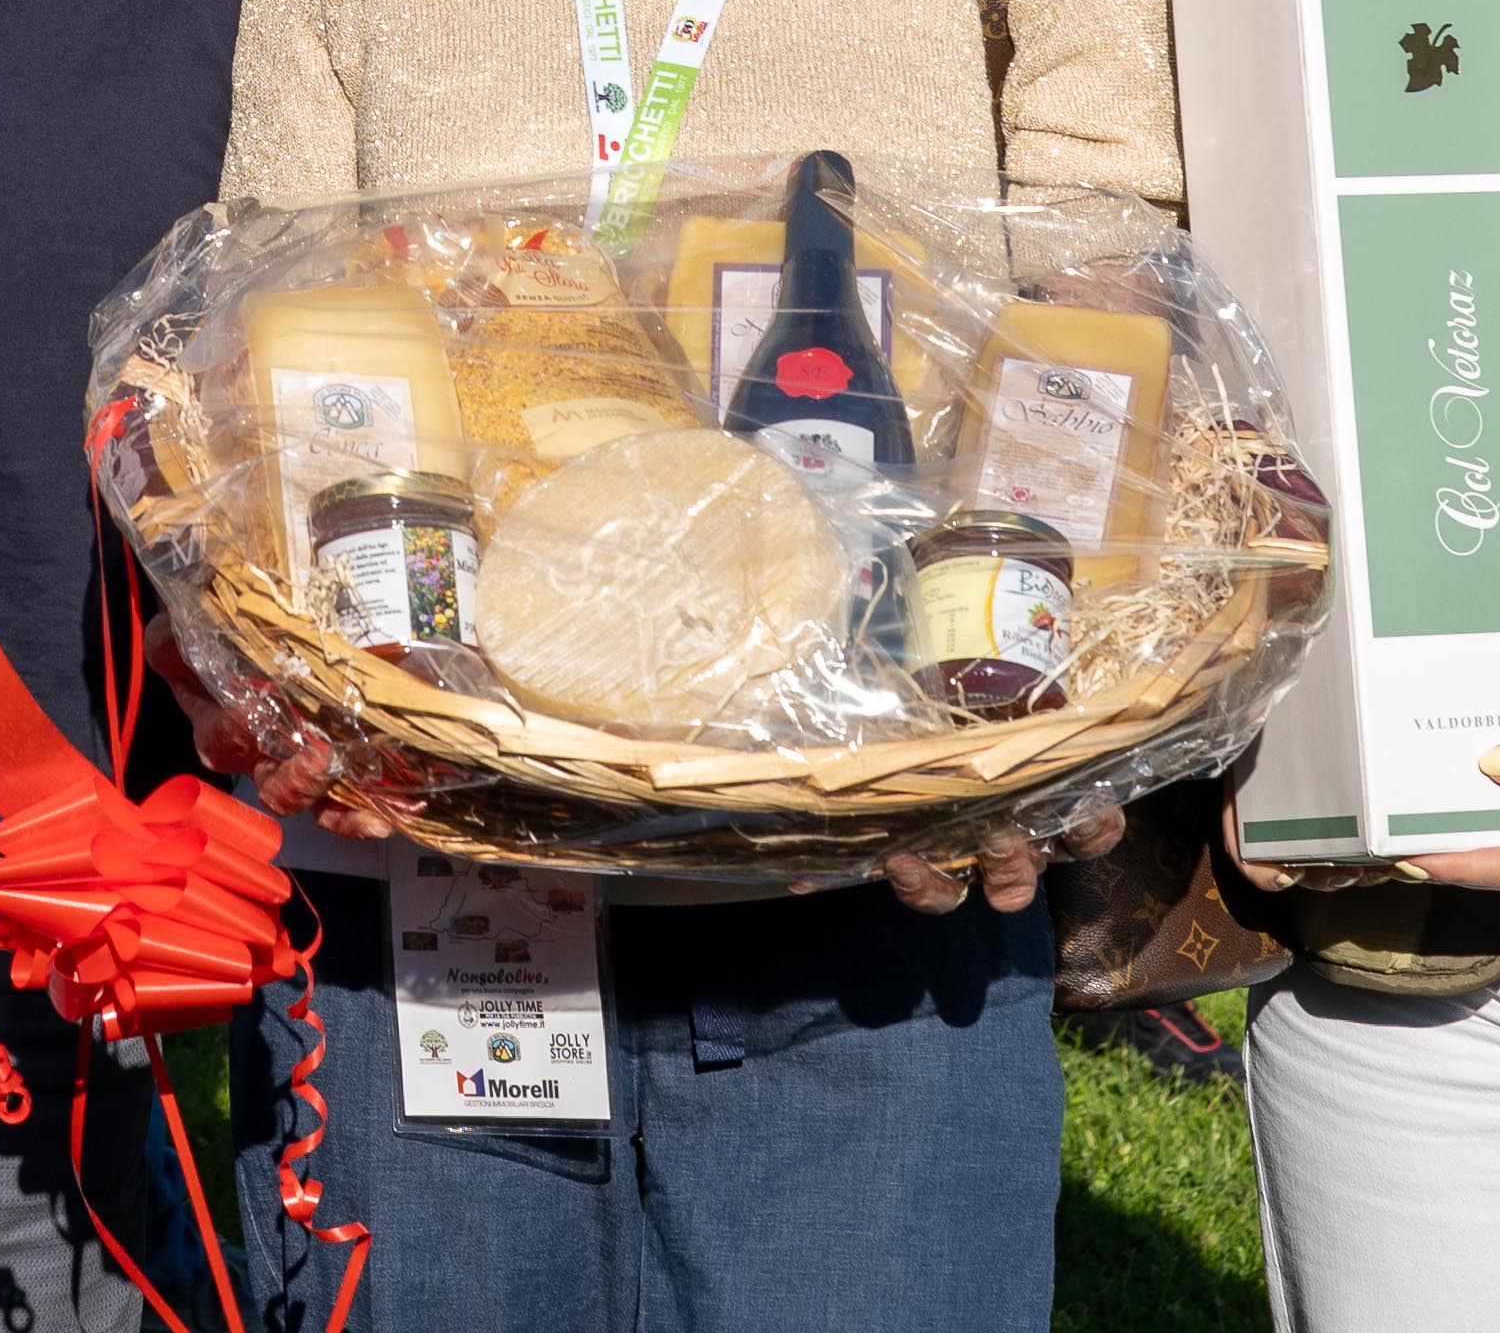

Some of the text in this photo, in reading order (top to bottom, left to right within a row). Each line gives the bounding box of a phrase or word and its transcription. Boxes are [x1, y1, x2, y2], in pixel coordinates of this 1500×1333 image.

[605, 69, 678, 229] BRICCHETTI
[478, 1000, 544, 1014] JOLLY TIME
[479, 1020, 546, 1030] www.jollytime.it
[549, 1033, 591, 1048] JOLLY
[488, 1079, 560, 1100] Morelli
